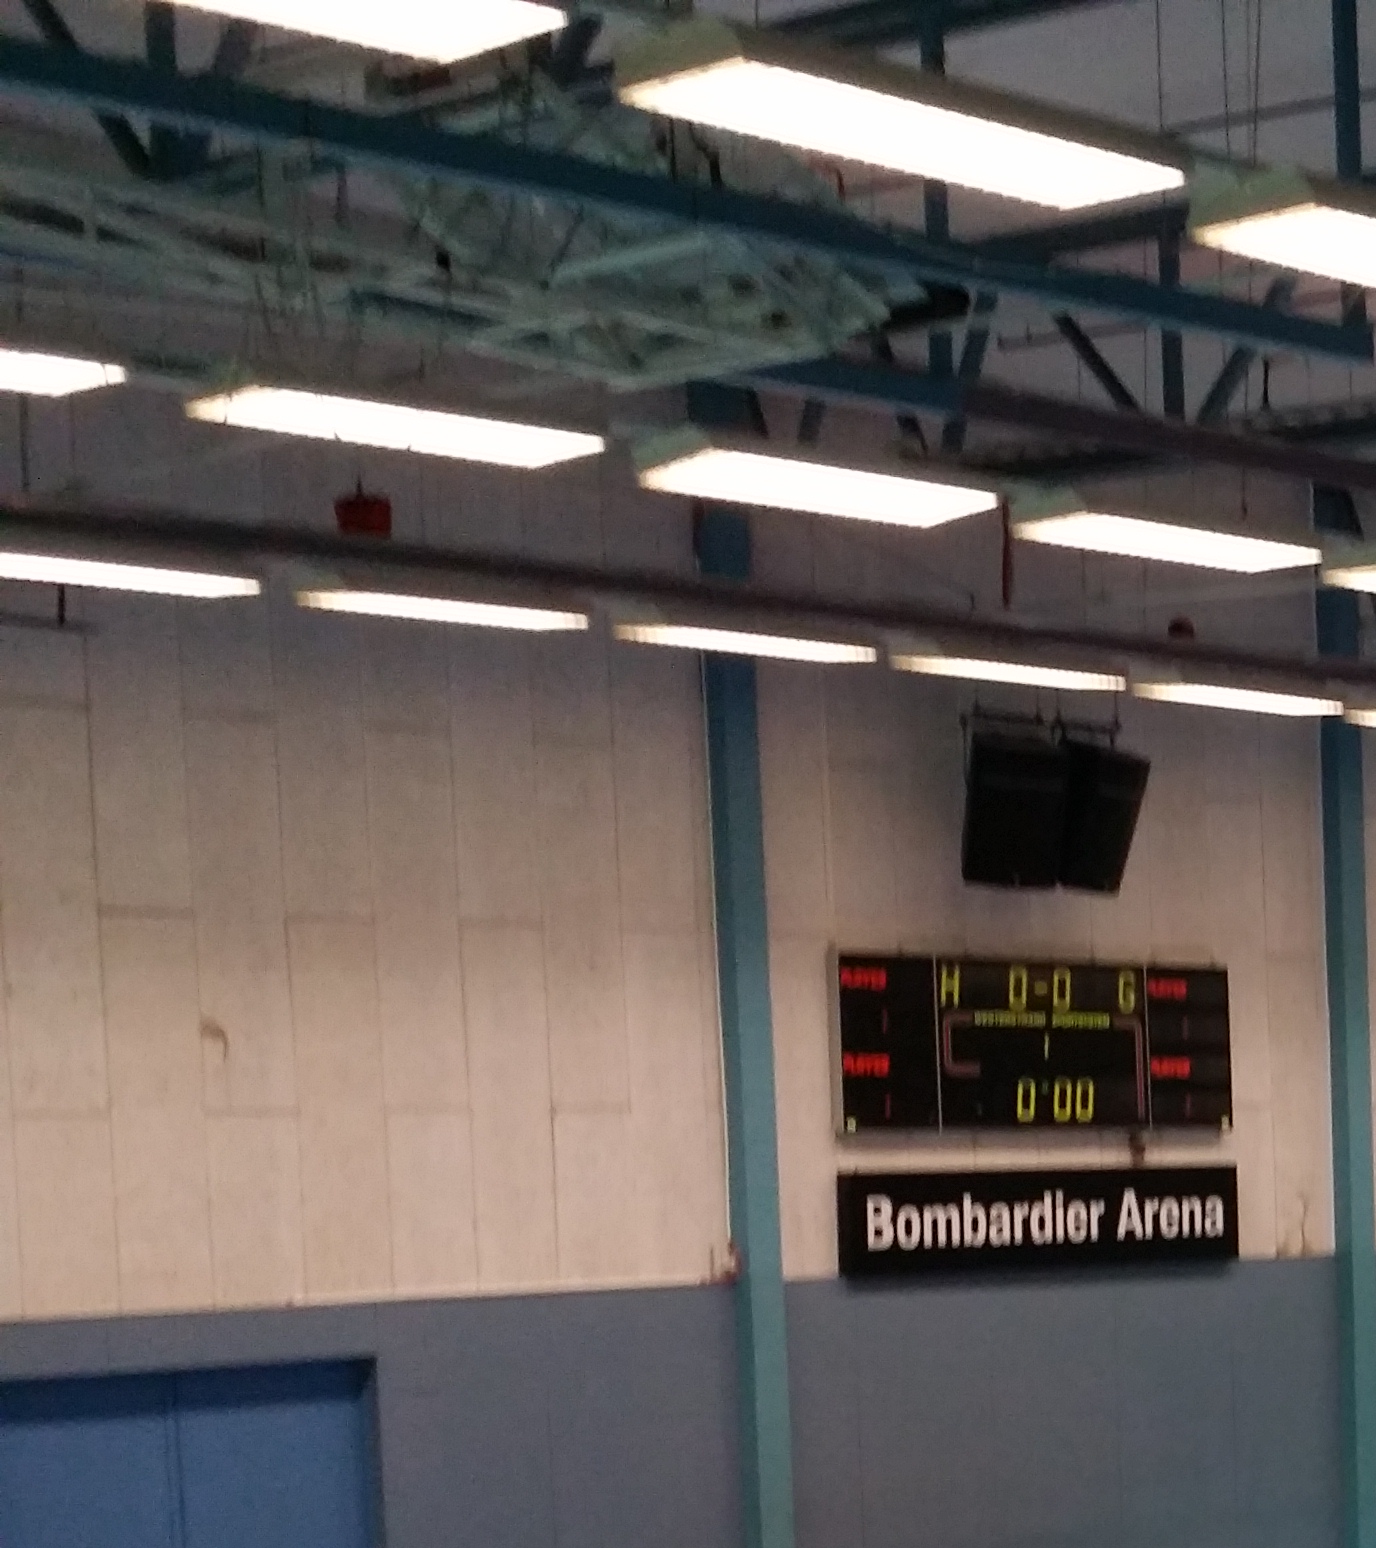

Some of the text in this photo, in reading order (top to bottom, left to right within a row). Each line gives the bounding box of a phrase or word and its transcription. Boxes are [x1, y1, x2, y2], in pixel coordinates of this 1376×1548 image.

[941, 964, 961, 1009] H
[1118, 970, 1136, 1014] G
[866, 1186, 1225, 1252] Bombardier Arena
